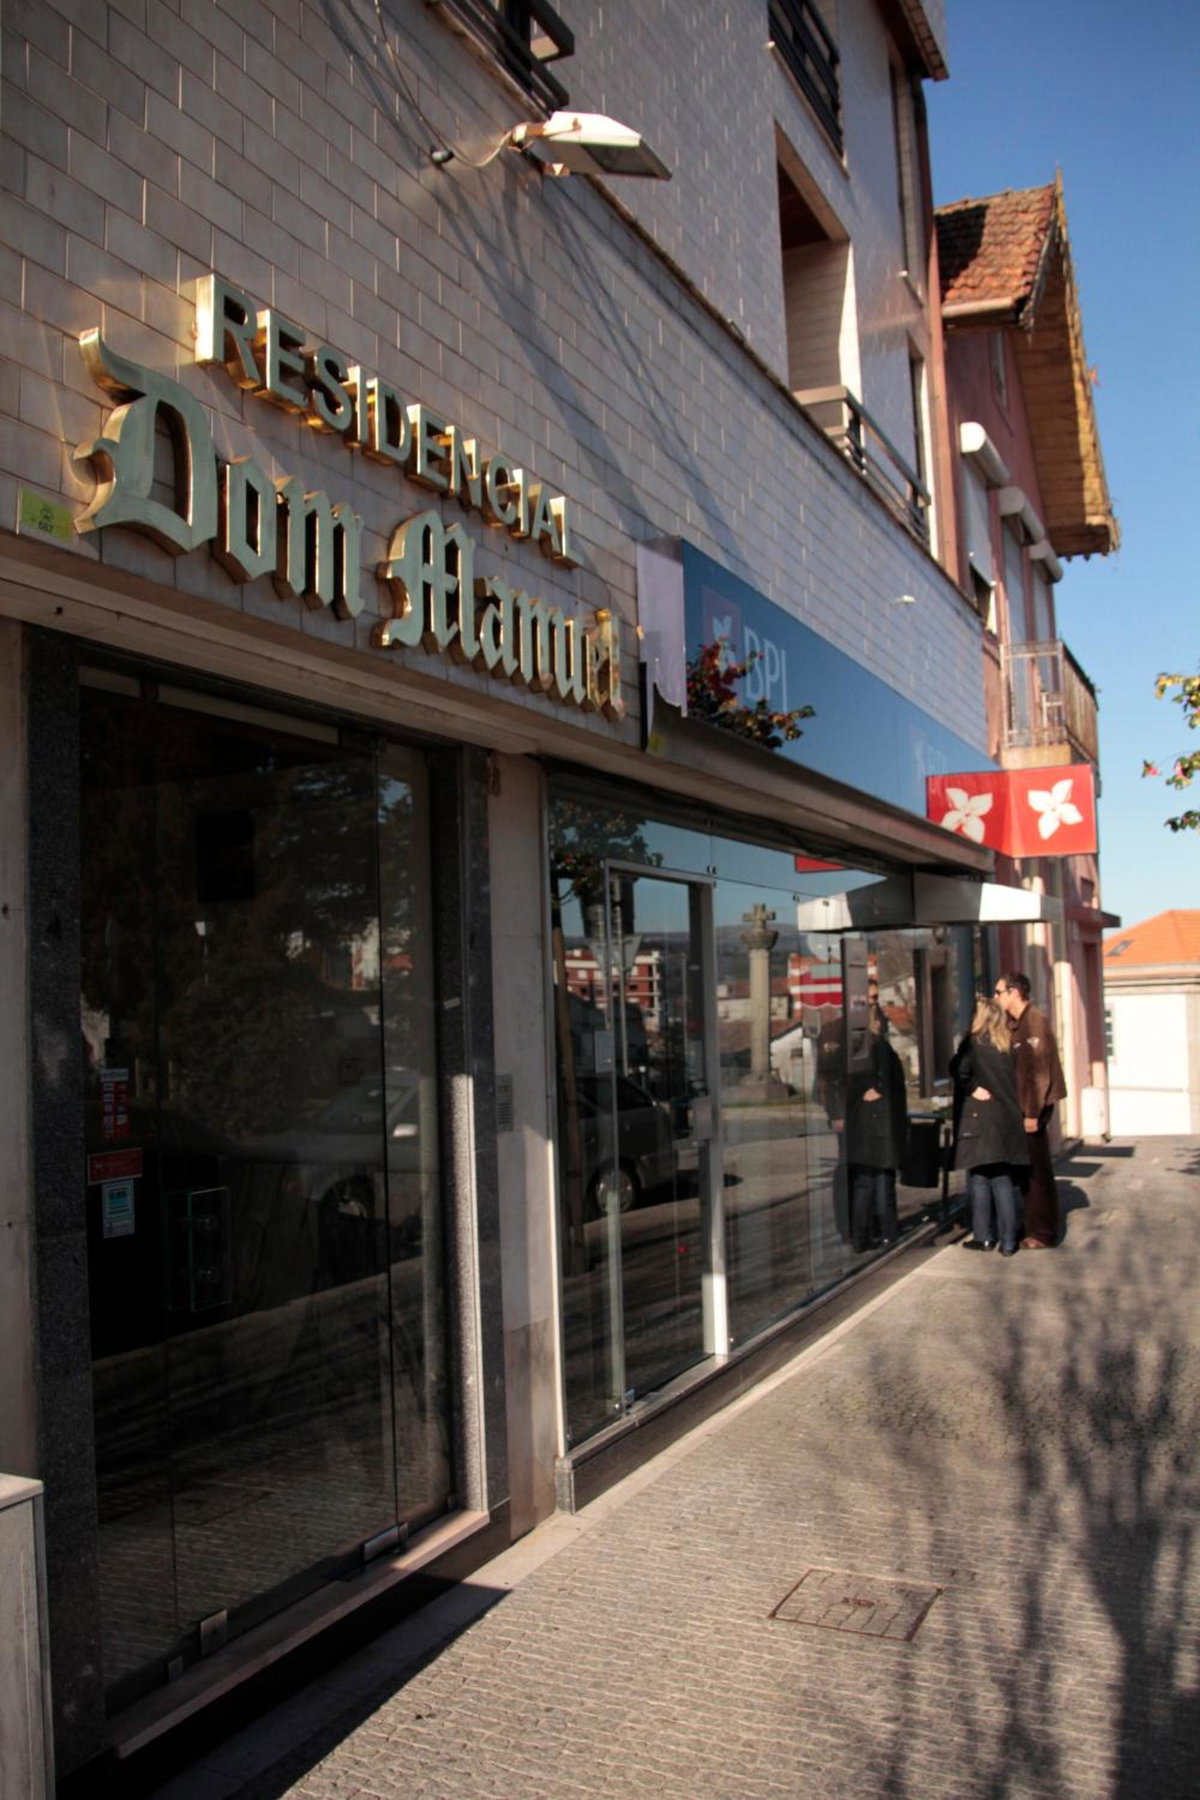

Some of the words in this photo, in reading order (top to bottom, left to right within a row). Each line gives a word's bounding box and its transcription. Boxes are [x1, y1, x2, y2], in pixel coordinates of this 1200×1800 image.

[73, 327, 365, 621] Dom
[370, 509, 622, 722] Manuel
[195, 273, 583, 568] RESIDENCIAL
[743, 626, 788, 715] BPI
